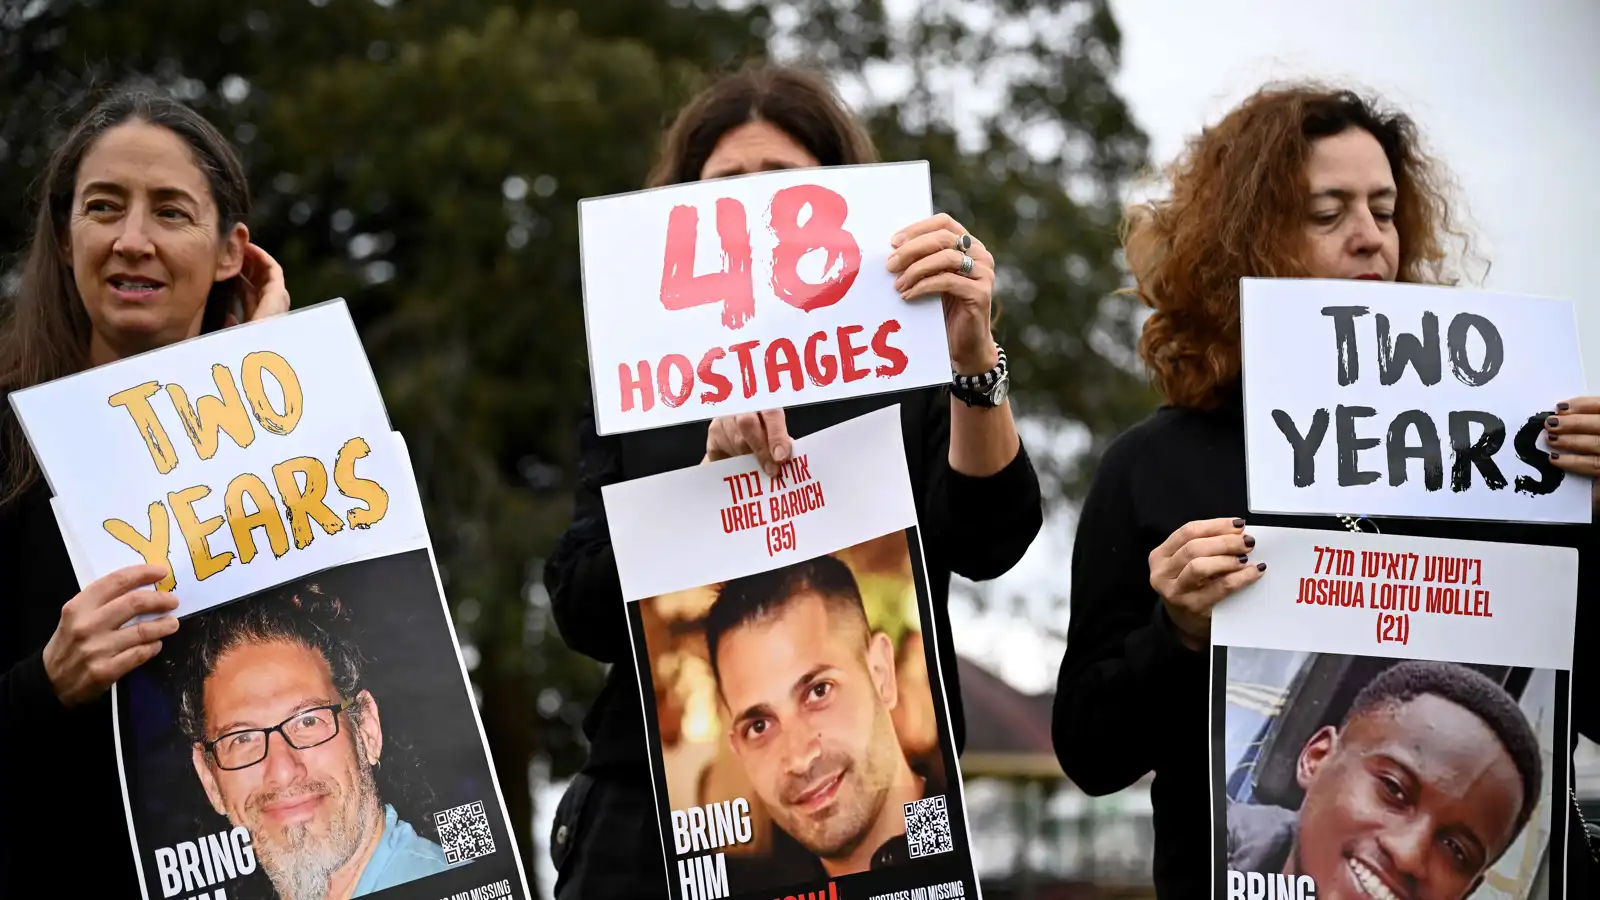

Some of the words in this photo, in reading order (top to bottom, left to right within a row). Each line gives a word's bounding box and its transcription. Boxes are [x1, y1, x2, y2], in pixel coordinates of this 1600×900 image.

[659, 184, 863, 330] 48
[618, 319, 909, 413] HOSTAGES
[1321, 305, 1504, 387] TWO
[108, 350, 303, 474] TWO
[1271, 404, 1566, 498] YEARS
[720, 500, 767, 534] URIEL
[769, 481, 825, 523] BARUCH
[723, 470, 764, 504] ברוך
[103, 437, 389, 593] YEARS
[766, 521, 797, 557] (35)
[1313, 545, 1355, 577] מולל
[1360, 550, 1419, 581] לואיטו
[1296, 578, 1365, 609] JOSHUA
[1370, 583, 1421, 612] LOITU
[1426, 587, 1493, 618] MOLLEL
[1376, 612, 1410, 645] (21)
[671, 797, 752, 855] BRING
[155, 826, 257, 899] BRING
[677, 852, 730, 900] HIM
[470, 879, 511, 900] MISSING
[928, 880, 965, 900] MISSING
